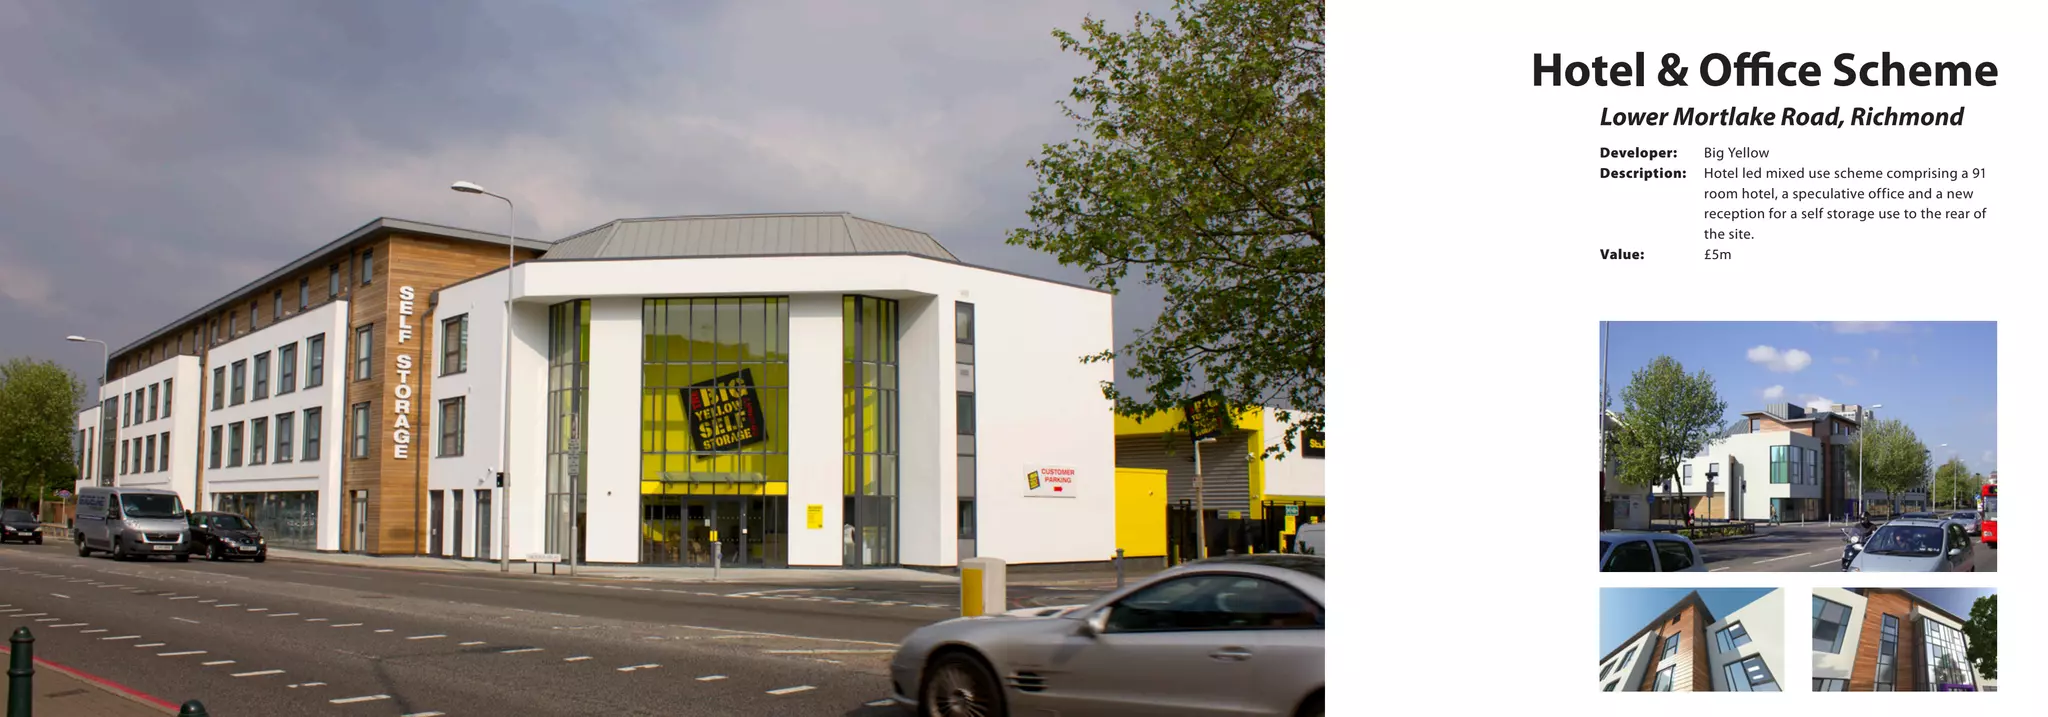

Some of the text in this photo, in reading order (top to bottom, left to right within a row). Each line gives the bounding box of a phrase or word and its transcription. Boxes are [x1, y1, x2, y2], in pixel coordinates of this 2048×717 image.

[393, 285, 415, 459] SELF STORAGE
[699, 377, 748, 407] BIG
[695, 399, 743, 421] YELLOW
[699, 410, 746, 438] SELF
[703, 428, 752, 450] STORAGE
